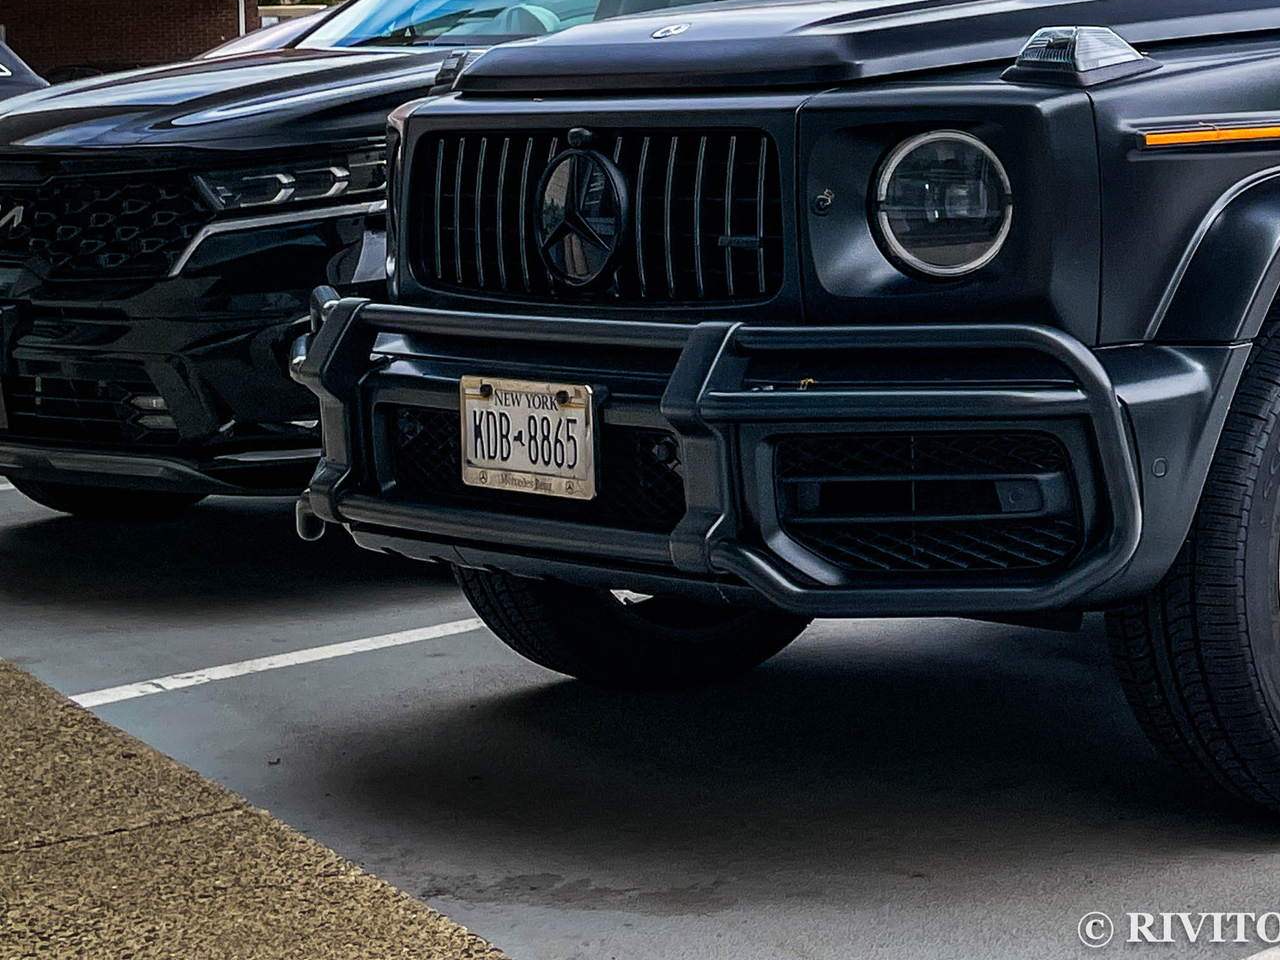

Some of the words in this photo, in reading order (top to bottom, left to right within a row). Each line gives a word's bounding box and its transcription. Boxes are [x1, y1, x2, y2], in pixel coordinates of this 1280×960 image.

[494, 389, 524, 408] NEW
[525, 393, 559, 411] YORK
[473, 410, 512, 462] KDB
[528, 415, 578, 470] 8865
